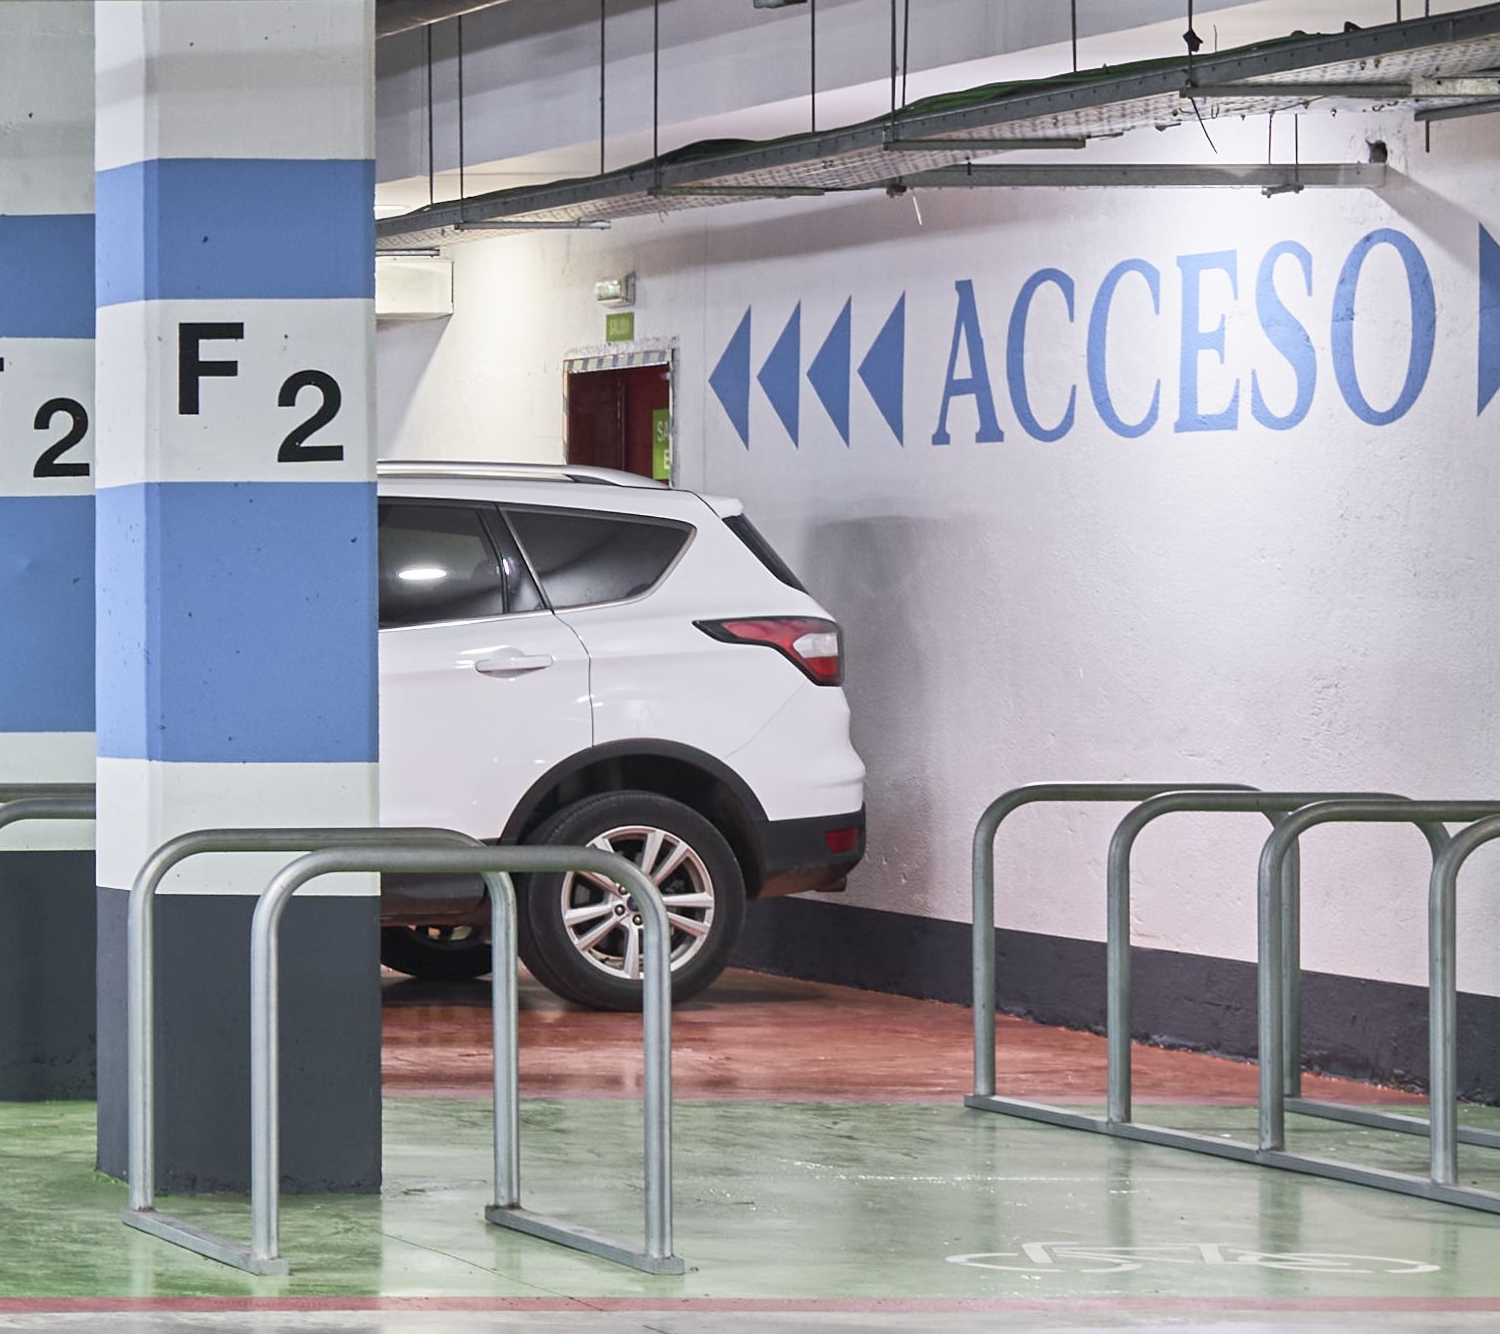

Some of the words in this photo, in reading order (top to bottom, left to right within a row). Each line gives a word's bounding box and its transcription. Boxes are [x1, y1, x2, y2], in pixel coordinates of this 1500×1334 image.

[178, 321, 245, 416] F
[277, 369, 344, 463] 2
[931, 227, 1437, 446] ACCESO
[32, 397, 91, 478] 2
